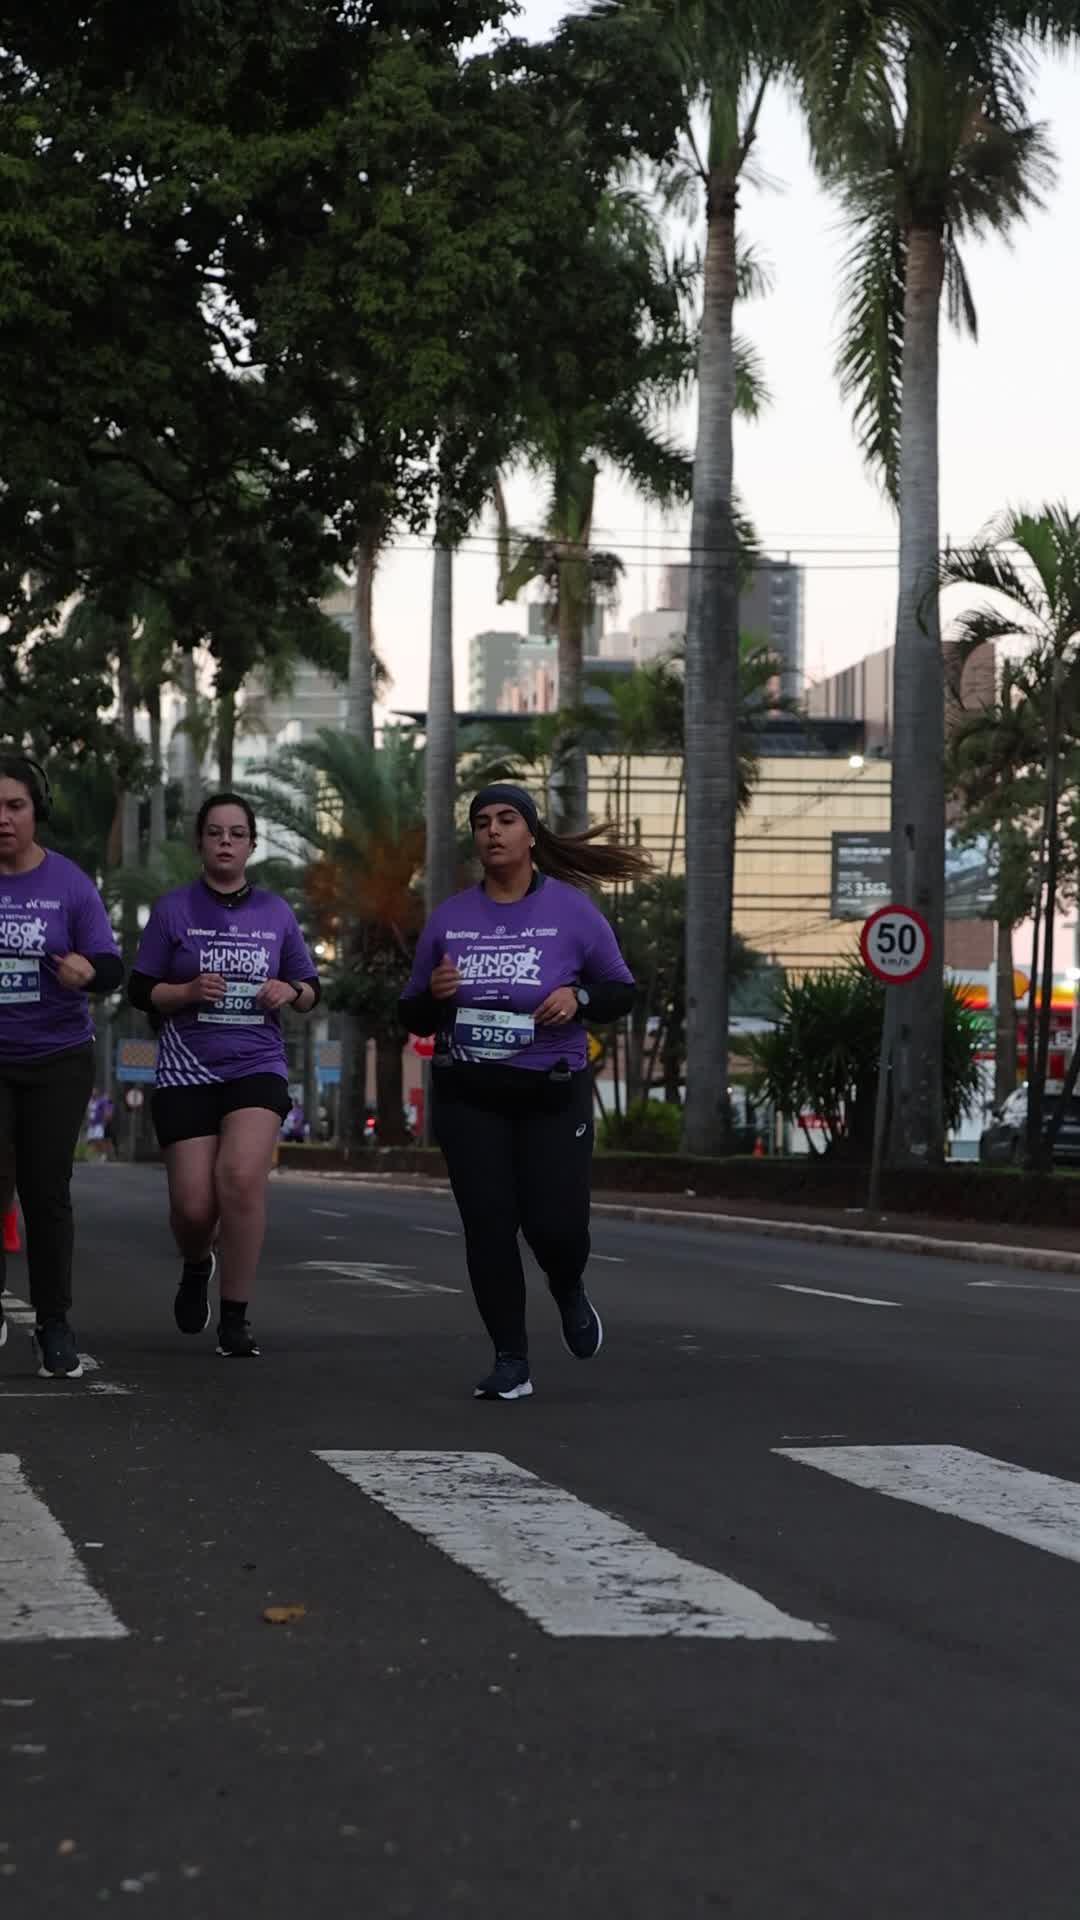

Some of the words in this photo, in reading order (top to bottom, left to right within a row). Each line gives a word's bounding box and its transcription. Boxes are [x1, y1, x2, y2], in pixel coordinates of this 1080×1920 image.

[877, 922, 916, 955] 50
[200, 948, 259, 960] MUNDO
[457, 952, 529, 967] MUNDO
[881, 956, 911, 966] km/h
[200, 960, 260, 974] MELHOR
[457, 965, 529, 979] MELHOR
[471, 1027, 516, 1043] 5956
